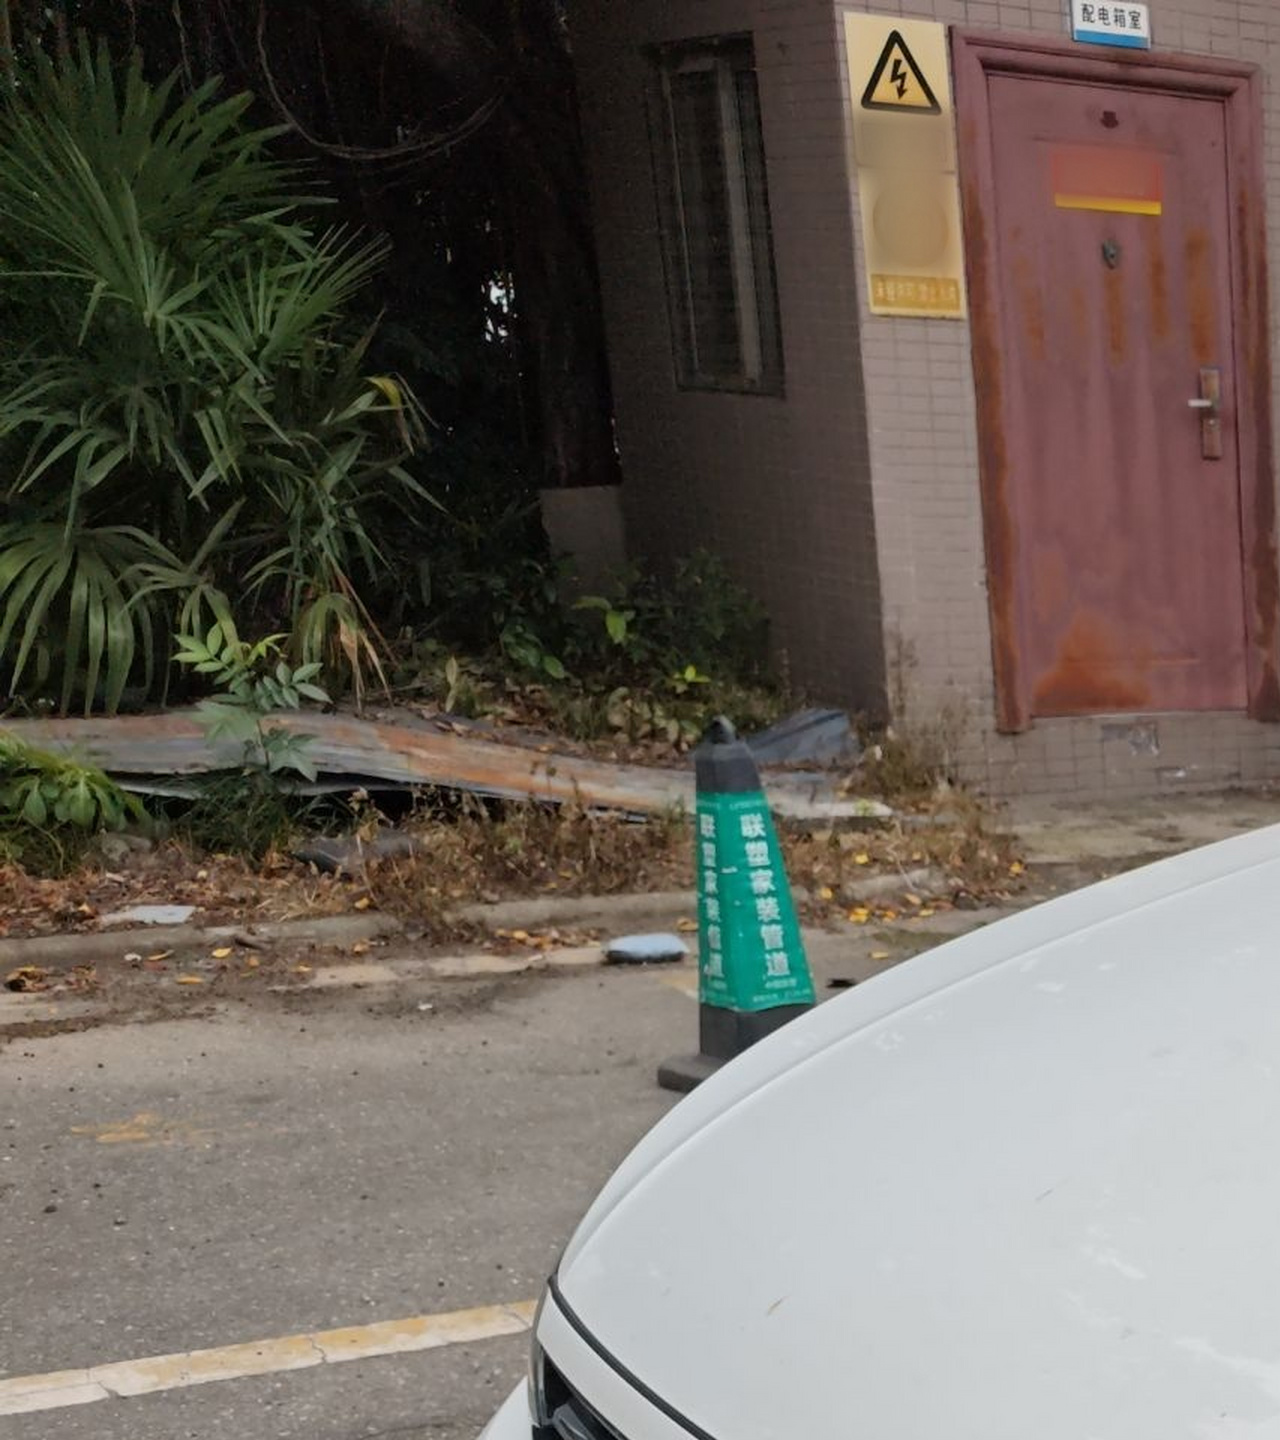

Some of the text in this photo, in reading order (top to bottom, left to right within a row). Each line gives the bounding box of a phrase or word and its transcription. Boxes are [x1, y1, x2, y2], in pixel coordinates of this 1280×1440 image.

[1081, 3, 1141, 29] 配电箱室
[740, 813, 790, 976] 联塑家装管道
